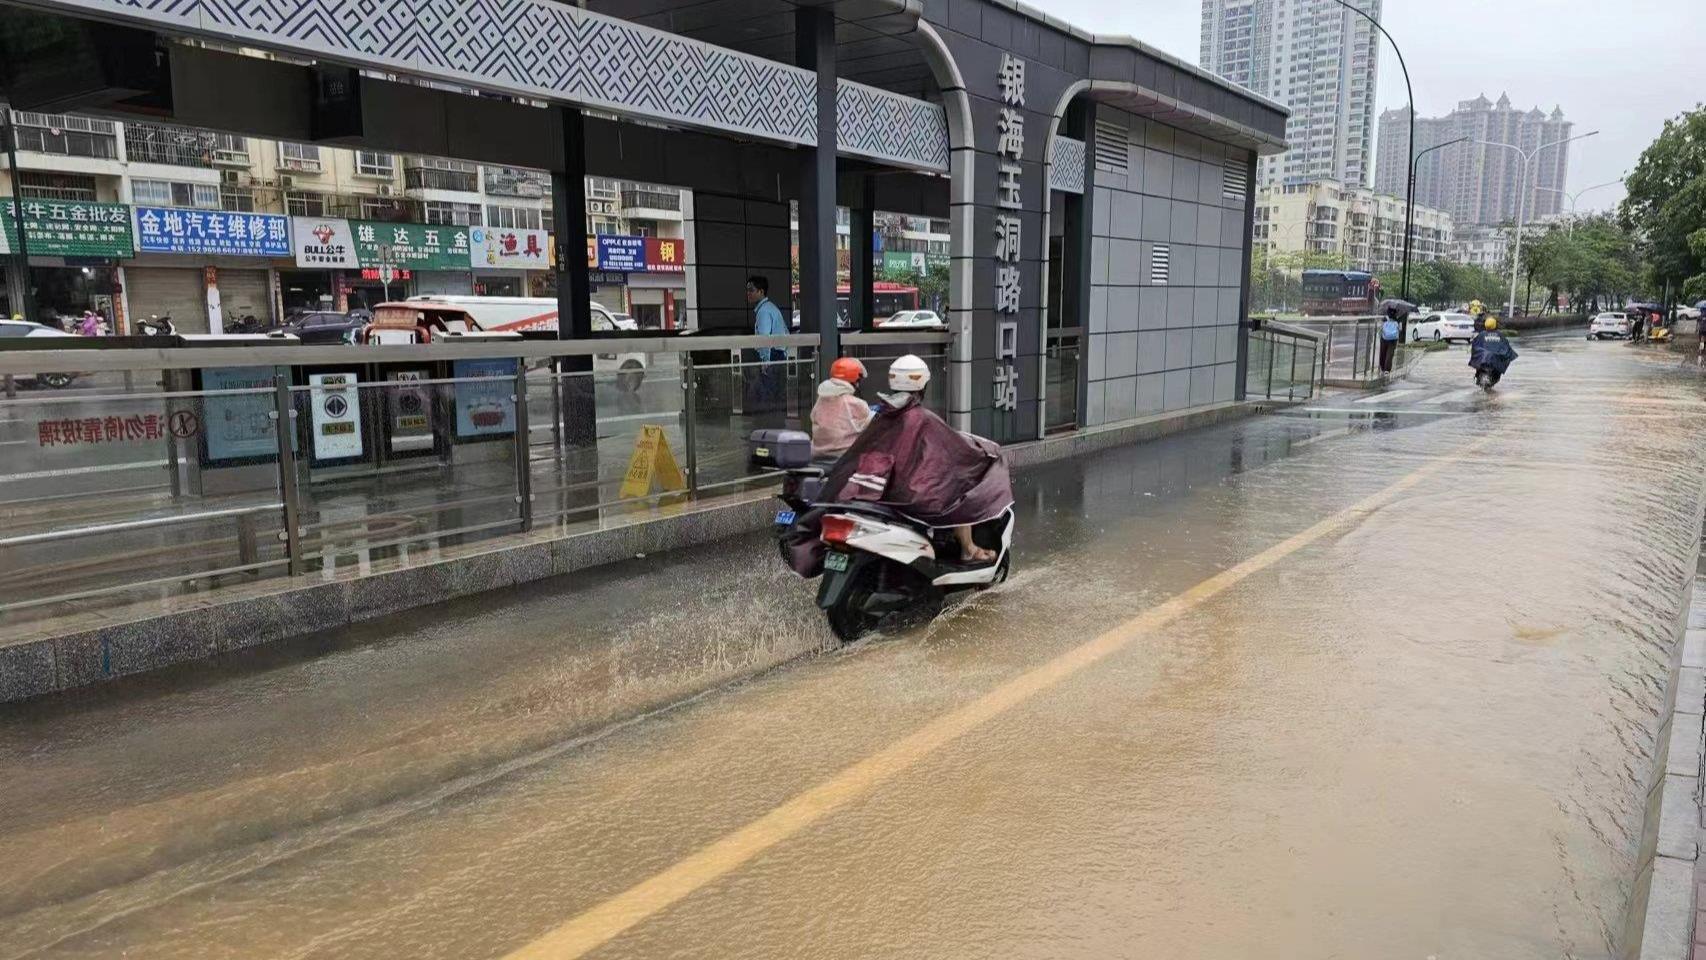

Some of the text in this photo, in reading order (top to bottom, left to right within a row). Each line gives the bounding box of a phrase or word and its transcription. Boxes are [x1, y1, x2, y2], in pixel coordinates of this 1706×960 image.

[140, 209, 286, 241] 金地汽车维修部
[358, 224, 468, 248] 雄达五金
[993, 53, 1027, 411] 银海玉洞路口站
[500, 233, 542, 258] 渔具
